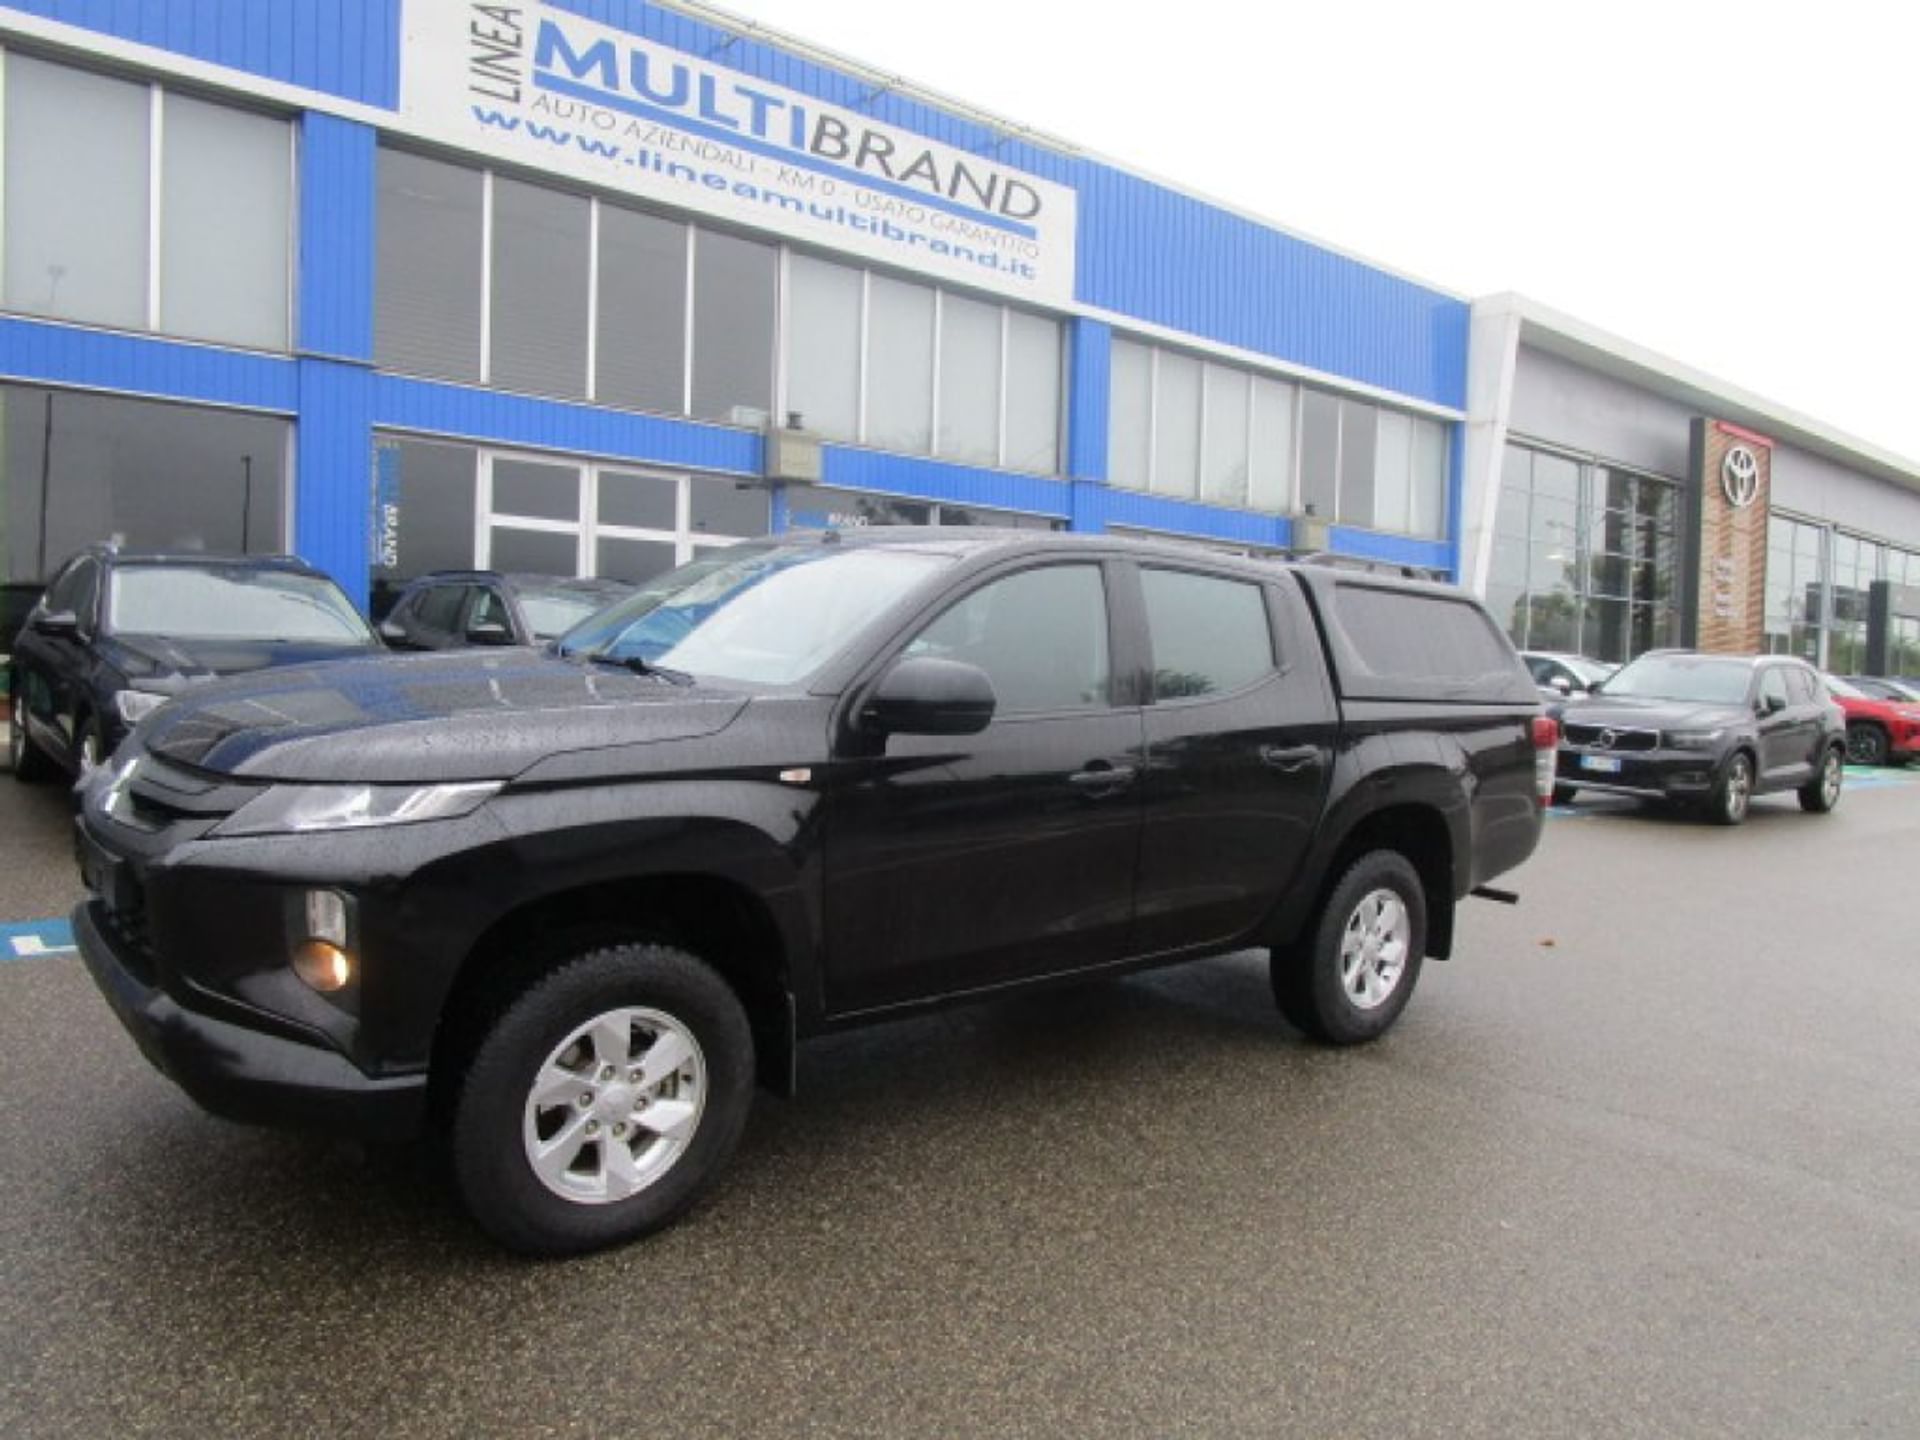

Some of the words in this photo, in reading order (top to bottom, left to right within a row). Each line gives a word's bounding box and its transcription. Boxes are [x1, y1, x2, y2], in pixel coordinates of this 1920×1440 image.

[469, 3, 523, 104] LINEA
[534, 18, 1042, 220] MULTIBRAND
[470, 105, 1037, 281] www.lineamultibrand.it
[531, 93, 617, 131] AUTO
[623, 118, 755, 174] AZIENDALI
[776, 165, 815, 192] KM
[855, 189, 926, 224] USATO
[930, 212, 1039, 259] GARANTITO
